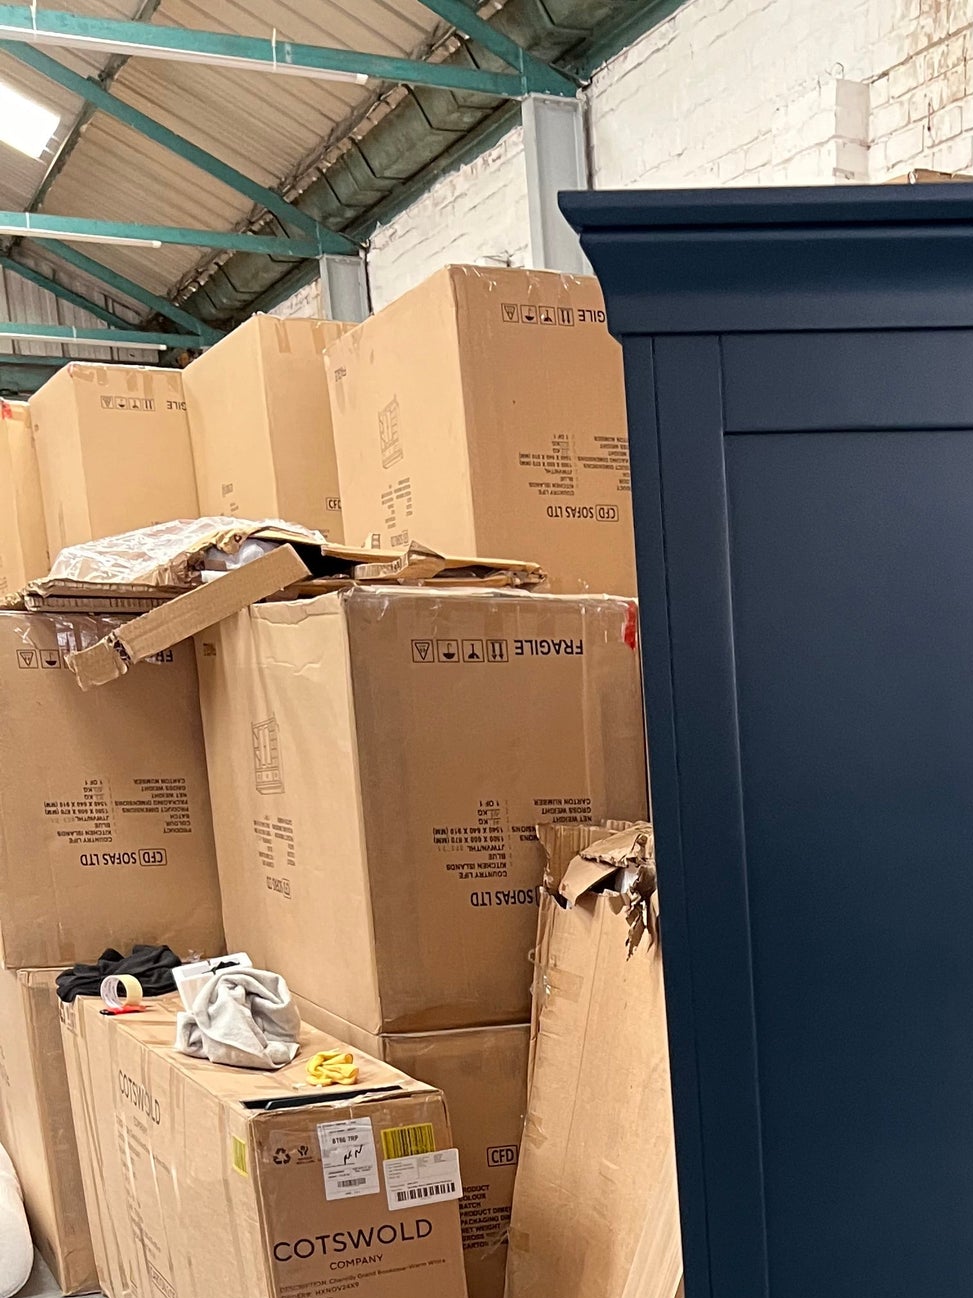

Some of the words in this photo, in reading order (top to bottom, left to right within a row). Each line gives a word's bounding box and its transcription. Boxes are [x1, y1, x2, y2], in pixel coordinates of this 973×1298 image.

[578, 309, 606, 322] GILE
[167, 401, 186, 411] GILE
[547, 506, 562, 518] LTD
[566, 506, 593, 518] SOFAS
[599, 508, 615, 518] CFD
[514, 640, 583, 655] FRAGILE
[80, 854, 99, 865] LTD
[103, 852, 136, 865] SOFAS
[143, 851, 163, 864] CFD
[471, 892, 491, 906] LTD
[495, 890, 532, 905] SOFAS
[119, 1070, 160, 1125] COTSWOLD
[492, 1149, 514, 1163] CFD
[274, 1219, 432, 1261] COTSWOLD
[330, 1254, 383, 1270] COMPANY
